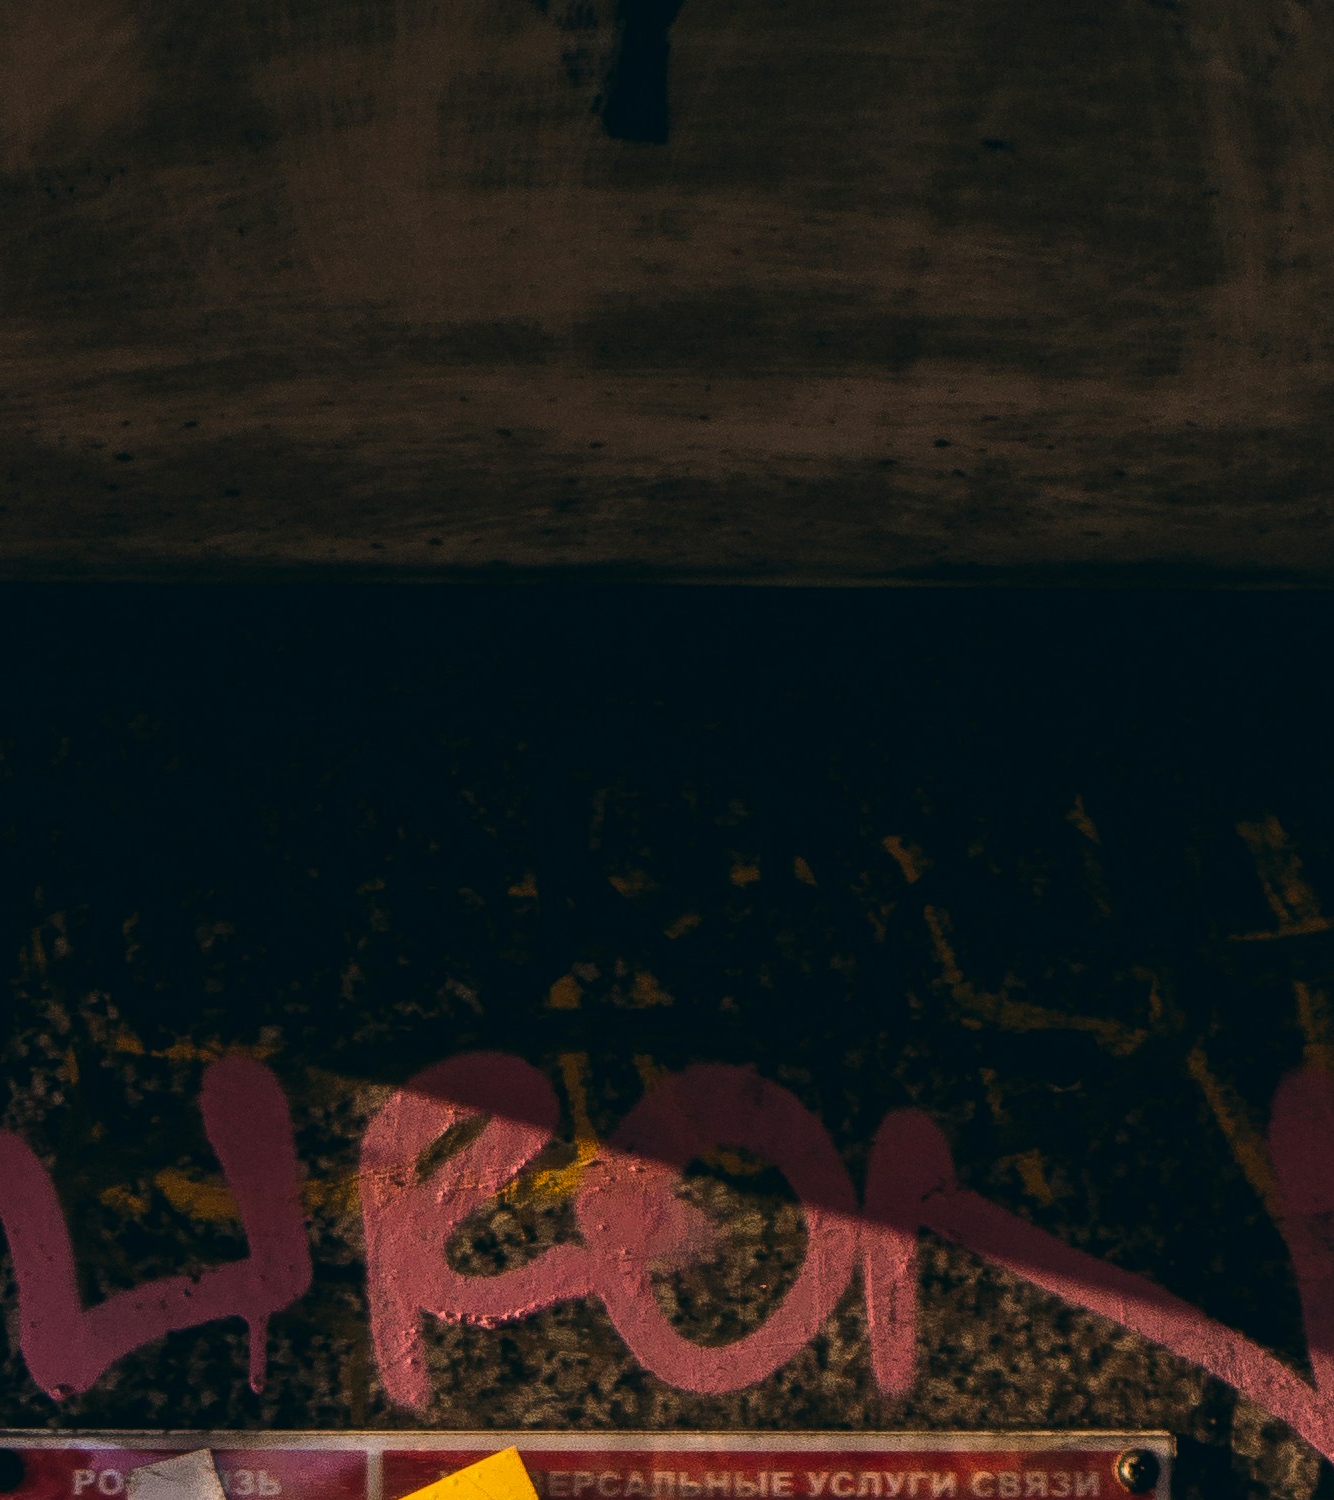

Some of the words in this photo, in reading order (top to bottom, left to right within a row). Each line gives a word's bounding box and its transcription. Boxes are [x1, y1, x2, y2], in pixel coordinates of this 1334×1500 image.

[73, 1468, 283, 1497] РОЗЬ
[535, 1470, 794, 1498] ЕРСАЛЬНЫЕ
[806, 1470, 959, 1498] УСЛУГИ
[970, 1470, 1101, 1498] СВЯЗИ
